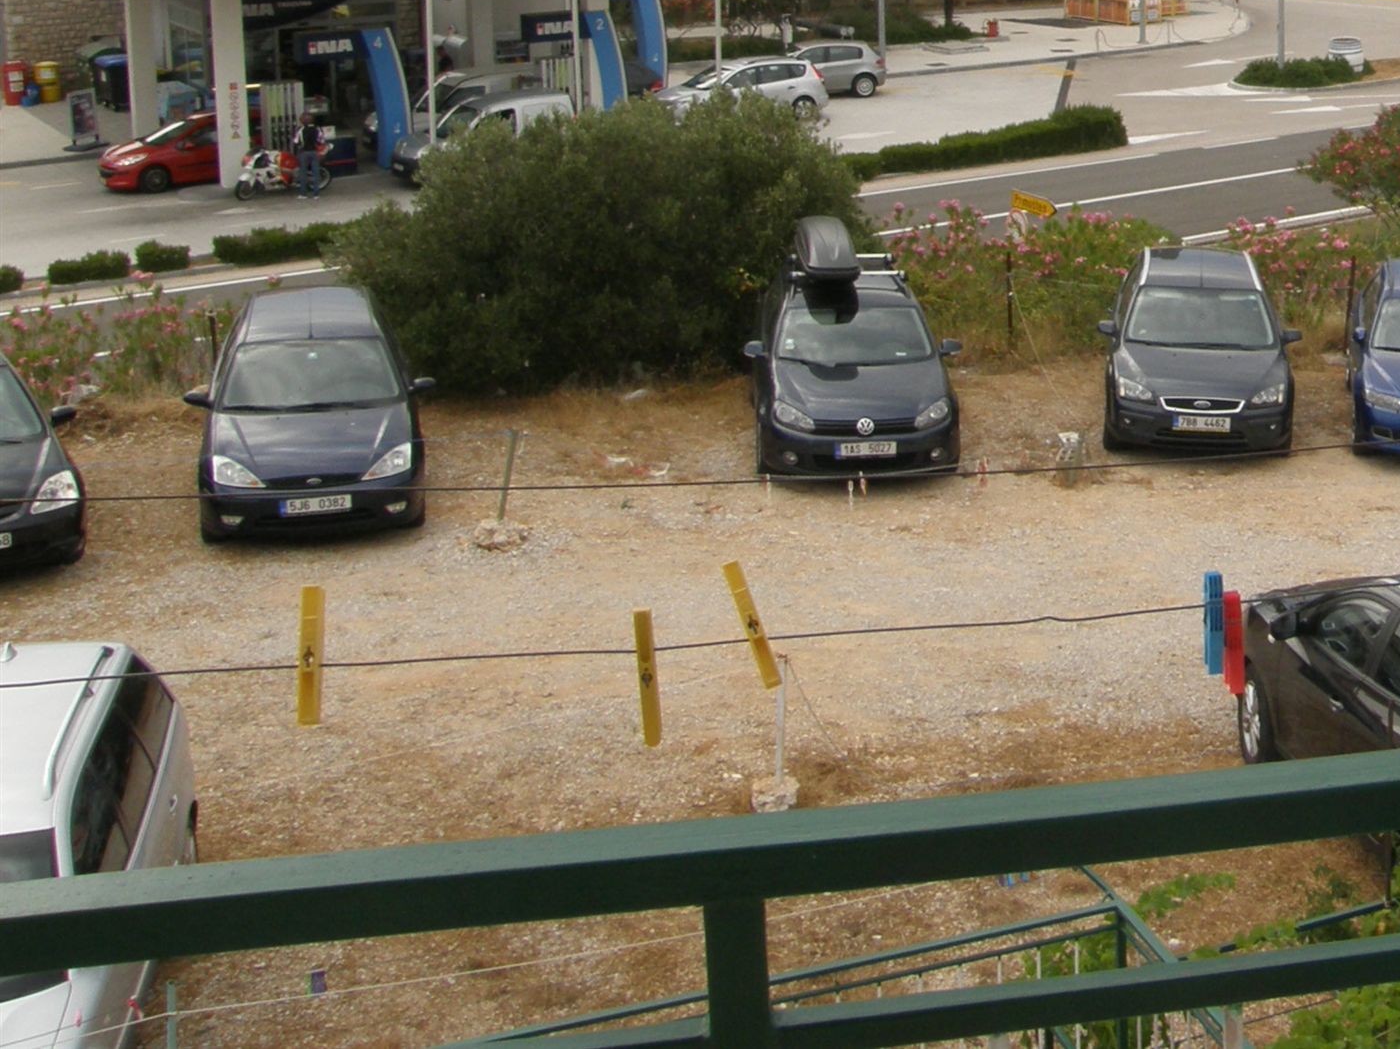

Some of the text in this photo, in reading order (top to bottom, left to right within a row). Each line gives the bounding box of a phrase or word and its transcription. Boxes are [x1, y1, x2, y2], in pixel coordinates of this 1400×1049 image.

[243, 3, 275, 17] NA
[596, 18, 605, 31] 2
[307, 36, 383, 55] INA 4
[289, 496, 346, 512] 5J6 0382
